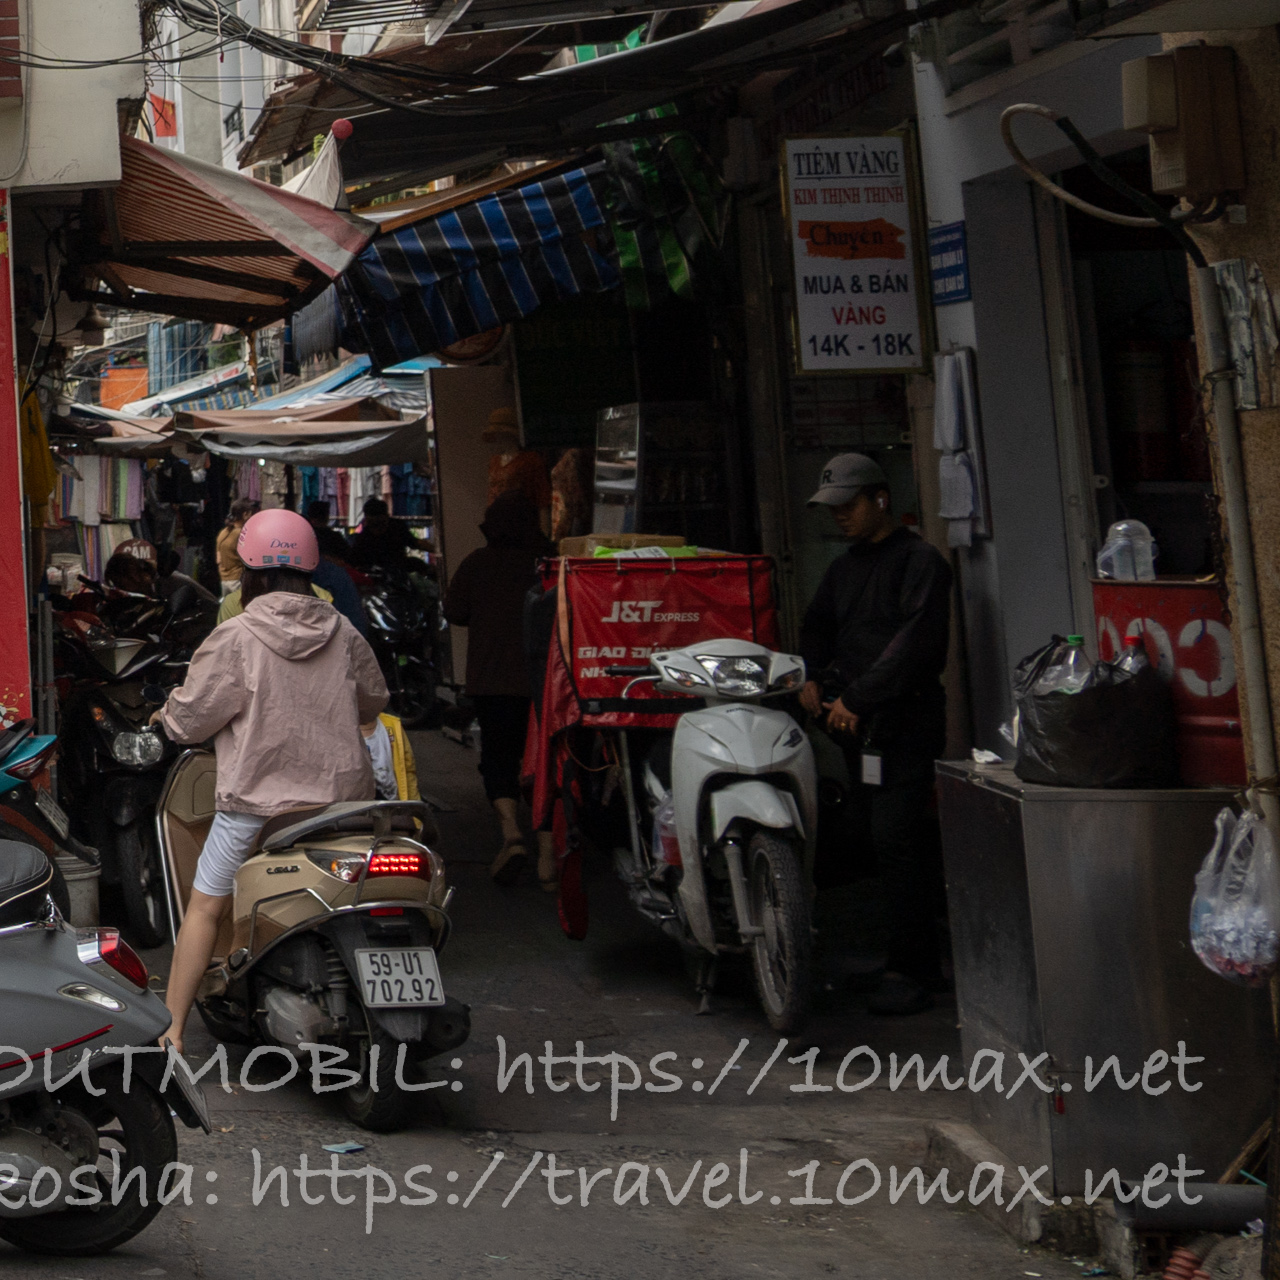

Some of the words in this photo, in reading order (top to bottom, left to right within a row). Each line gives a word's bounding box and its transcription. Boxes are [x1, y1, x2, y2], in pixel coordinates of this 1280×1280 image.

[794, 146, 841, 181] TIỆM
[845, 144, 900, 175] VÀNG
[794, 189, 817, 205] KIM
[803, 274, 845, 295] MUA
[850, 275, 864, 293] &
[868, 270, 909, 294] BÁN
[831, 301, 887, 326] VÀNG
[808, 334, 851, 358] 14K
[872, 333, 914, 357] 18K
[270, 539, 298, 549] Dove
[601, 600, 664, 623] J&T
[653, 612, 701, 623] EXPRESS
[577, 646, 626, 659] GIAO
[367, 951, 424, 977] 59-U1
[366, 977, 439, 1005] 702.92
